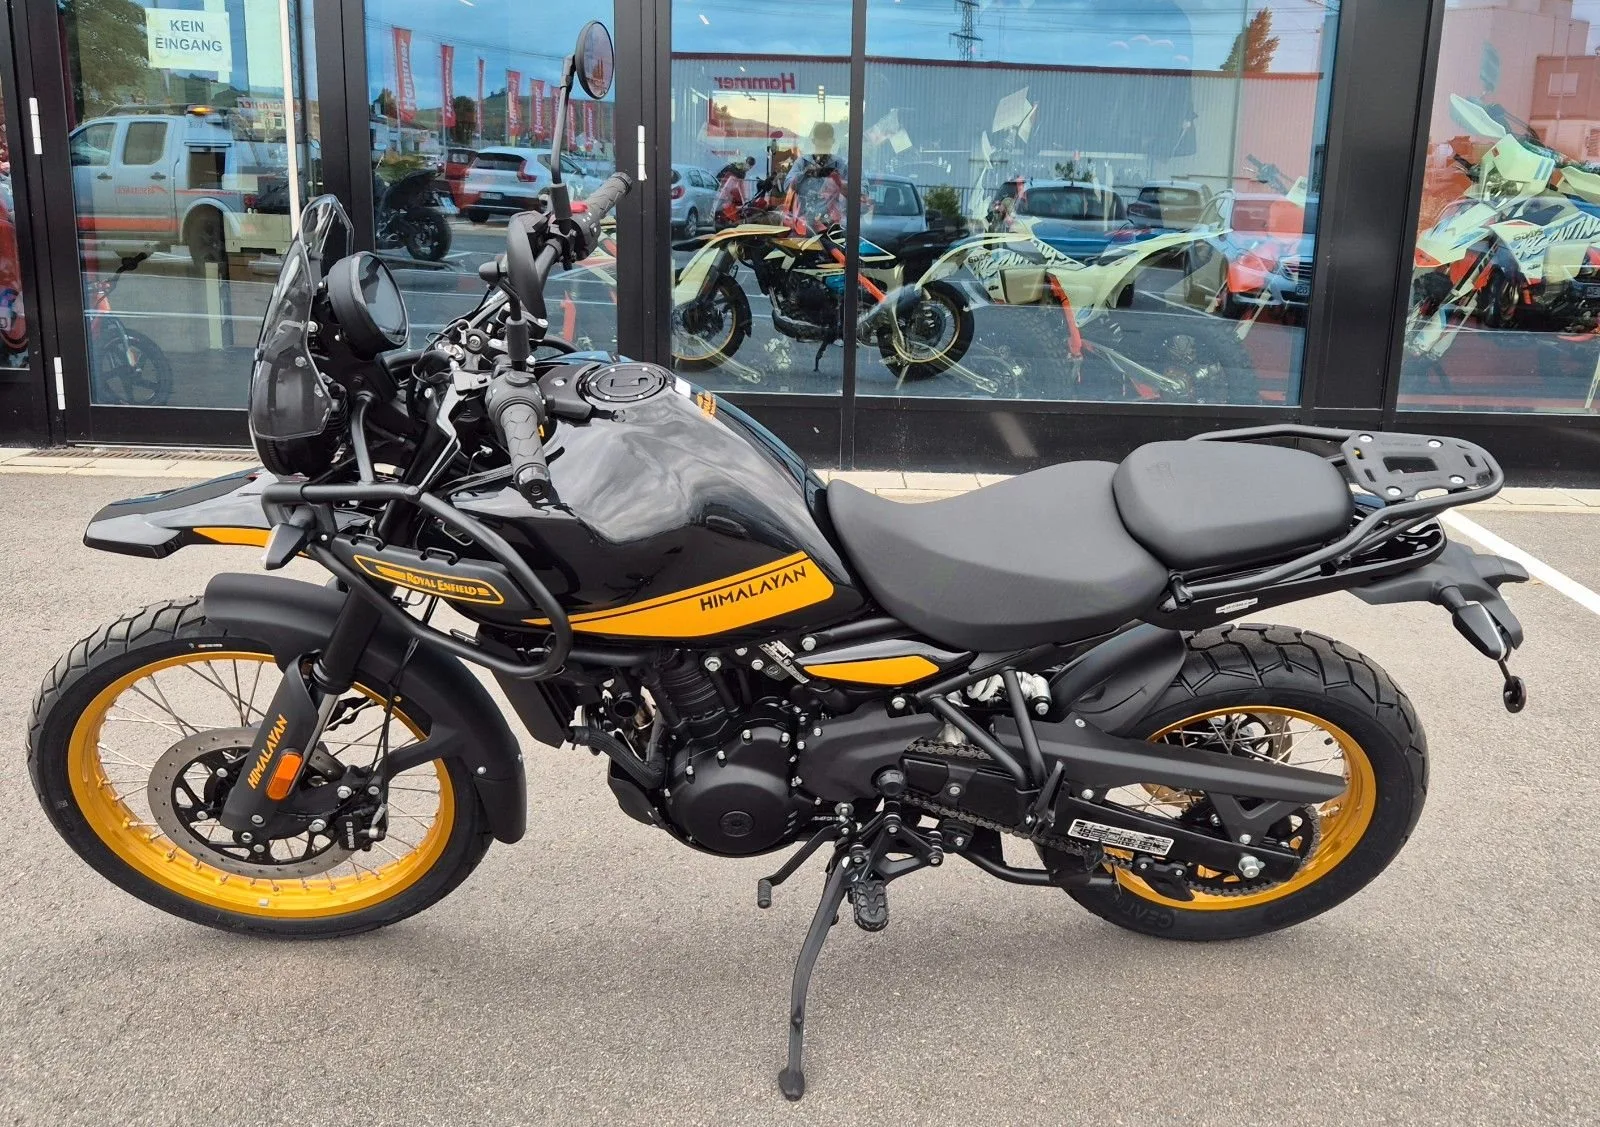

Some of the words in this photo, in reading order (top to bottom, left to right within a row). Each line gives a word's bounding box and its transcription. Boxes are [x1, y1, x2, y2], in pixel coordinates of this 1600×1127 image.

[154, 37, 223, 52] EINGANG
[170, 19, 205, 33] KEIN
[398, 38, 416, 111] Hammer
[532, 86, 545, 134] Hammer
[406, 572, 437, 588] ROYAL
[437, 579, 477, 596] ENFIELD
[700, 565, 807, 612] HIMALAYAN
[247, 713, 288, 790] HIMALAYAN
